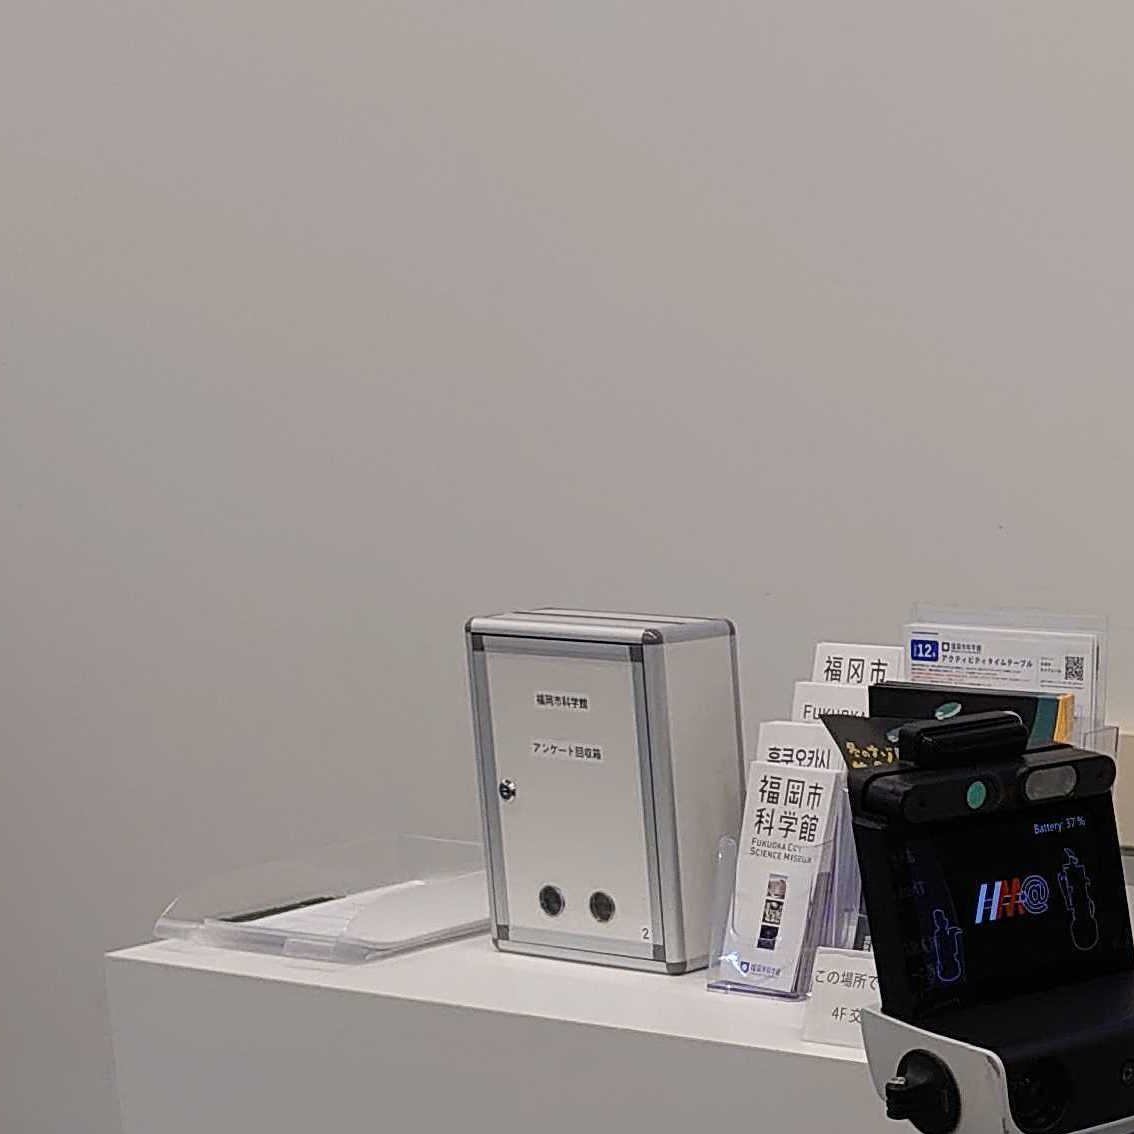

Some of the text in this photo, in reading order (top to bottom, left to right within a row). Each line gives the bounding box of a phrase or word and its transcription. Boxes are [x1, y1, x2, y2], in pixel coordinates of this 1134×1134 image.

[759, 775, 824, 810] 福岡市
[754, 807, 819, 842] 科学館
[642, 927, 650, 940] 2
[815, 970, 879, 991] この場所で
[831, 1007, 847, 1021] 4F
